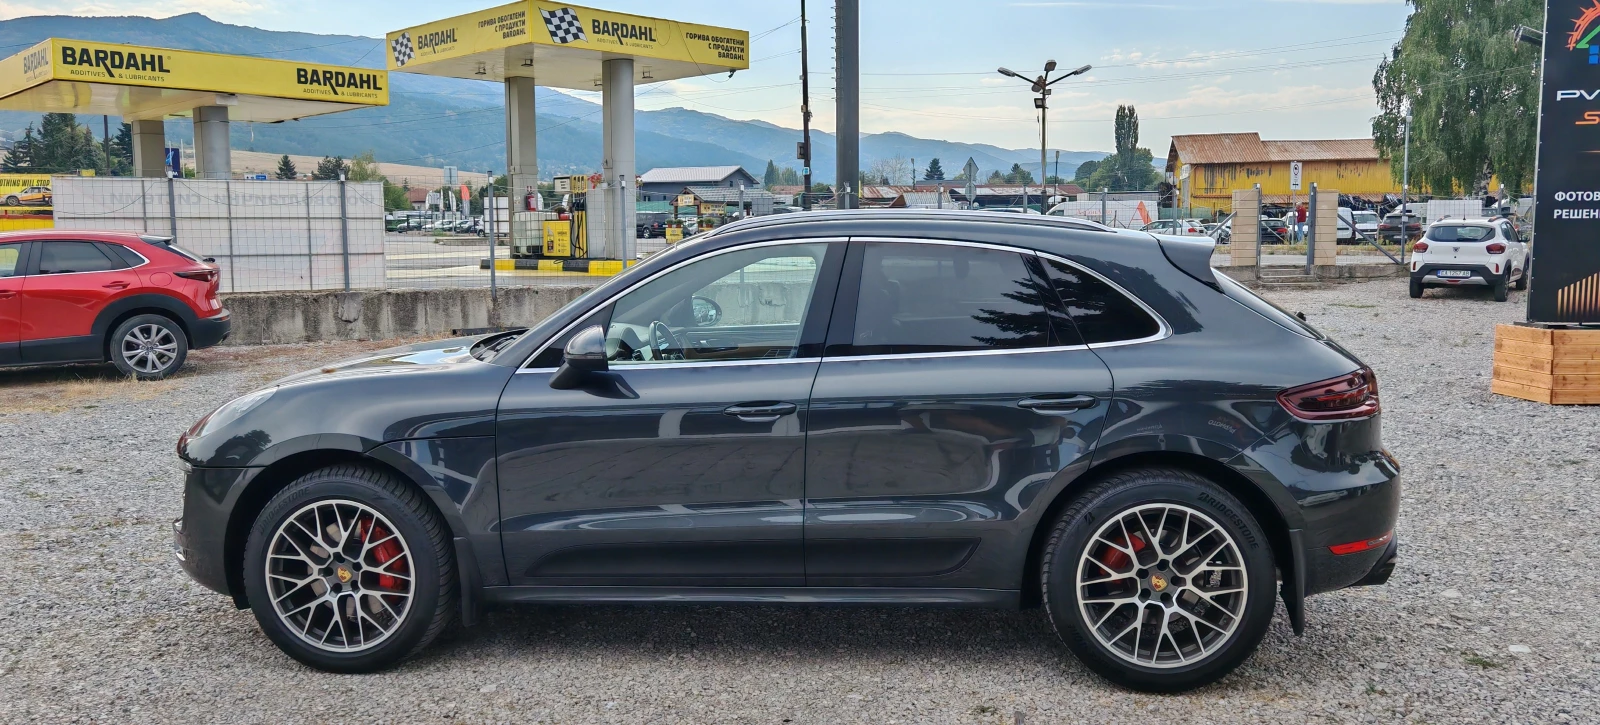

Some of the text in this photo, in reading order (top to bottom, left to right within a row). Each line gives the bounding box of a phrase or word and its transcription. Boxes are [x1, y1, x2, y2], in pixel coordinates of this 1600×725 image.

[478, 10, 526, 28] ГОРИВА ОБОГАТЕНИ
[499, 19, 526, 32] ПРОДУКТИ
[503, 28, 526, 39] BARDAHL
[592, 19, 656, 45] BARDAHL
[686, 32, 744, 46] ГОРИВА ОБОГАТЕНИ
[418, 27, 457, 54] BARDAHL
[713, 44, 744, 53] ПРОДУКТИ
[24, 47, 48, 79] BARDAHL
[62, 46, 170, 78] BARDAHL
[718, 52, 744, 61] BARDAHL
[297, 68, 382, 95] BARDAHL
[1554, 191, 1600, 202] ФОТОВ
[1554, 209, 1600, 219] РЕШЕН
[1197, 492, 1259, 549] BRIDGESTONE
